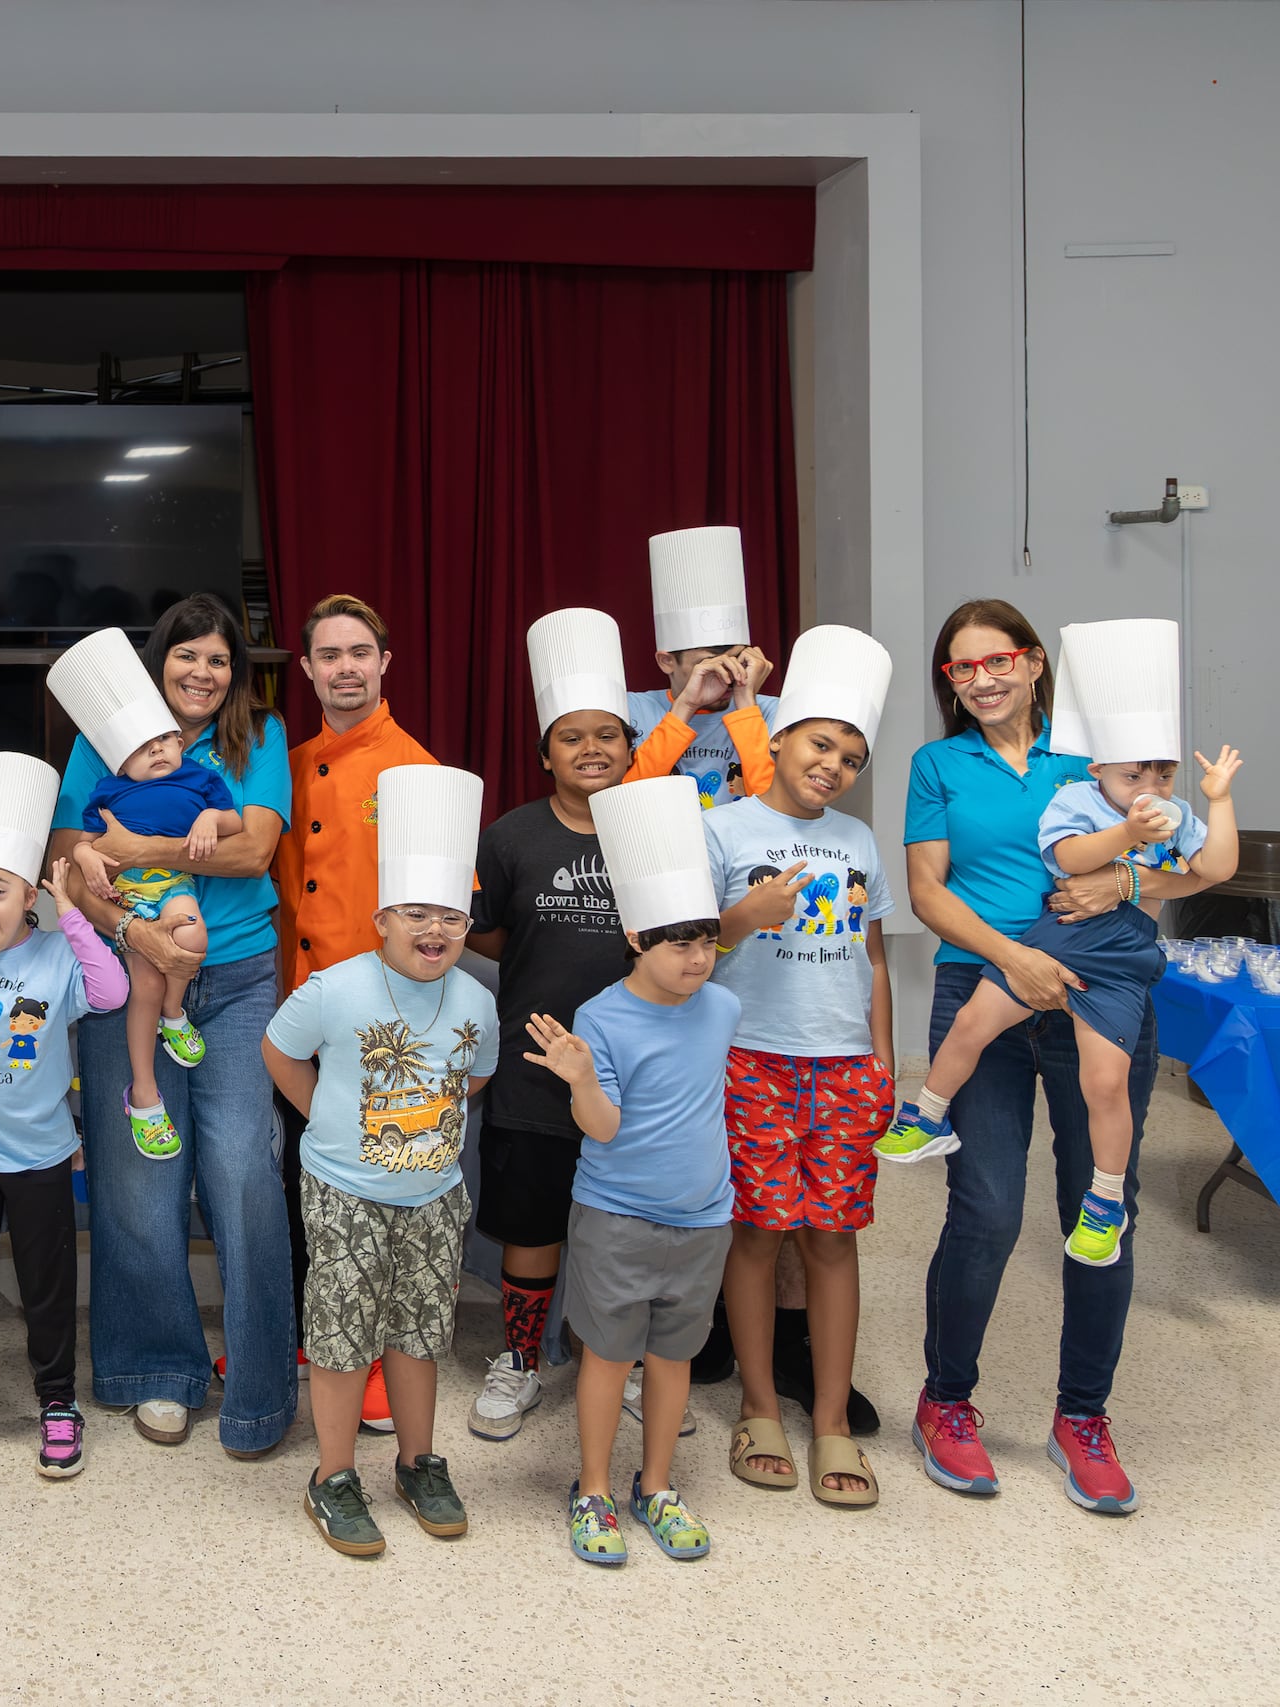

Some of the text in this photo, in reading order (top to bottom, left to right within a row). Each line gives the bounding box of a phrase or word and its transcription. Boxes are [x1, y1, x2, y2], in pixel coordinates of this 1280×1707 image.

[791, 843, 851, 863] diferente
[535, 893, 579, 908] down
[582, 894, 610, 910] the
[539, 914, 546, 922] A
[551, 913, 587, 923] PLACE
[591, 915, 606, 925] TO
[776, 948, 793, 959] no
[798, 951, 816, 963] me
[387, 1142, 451, 1173] HURLEY
